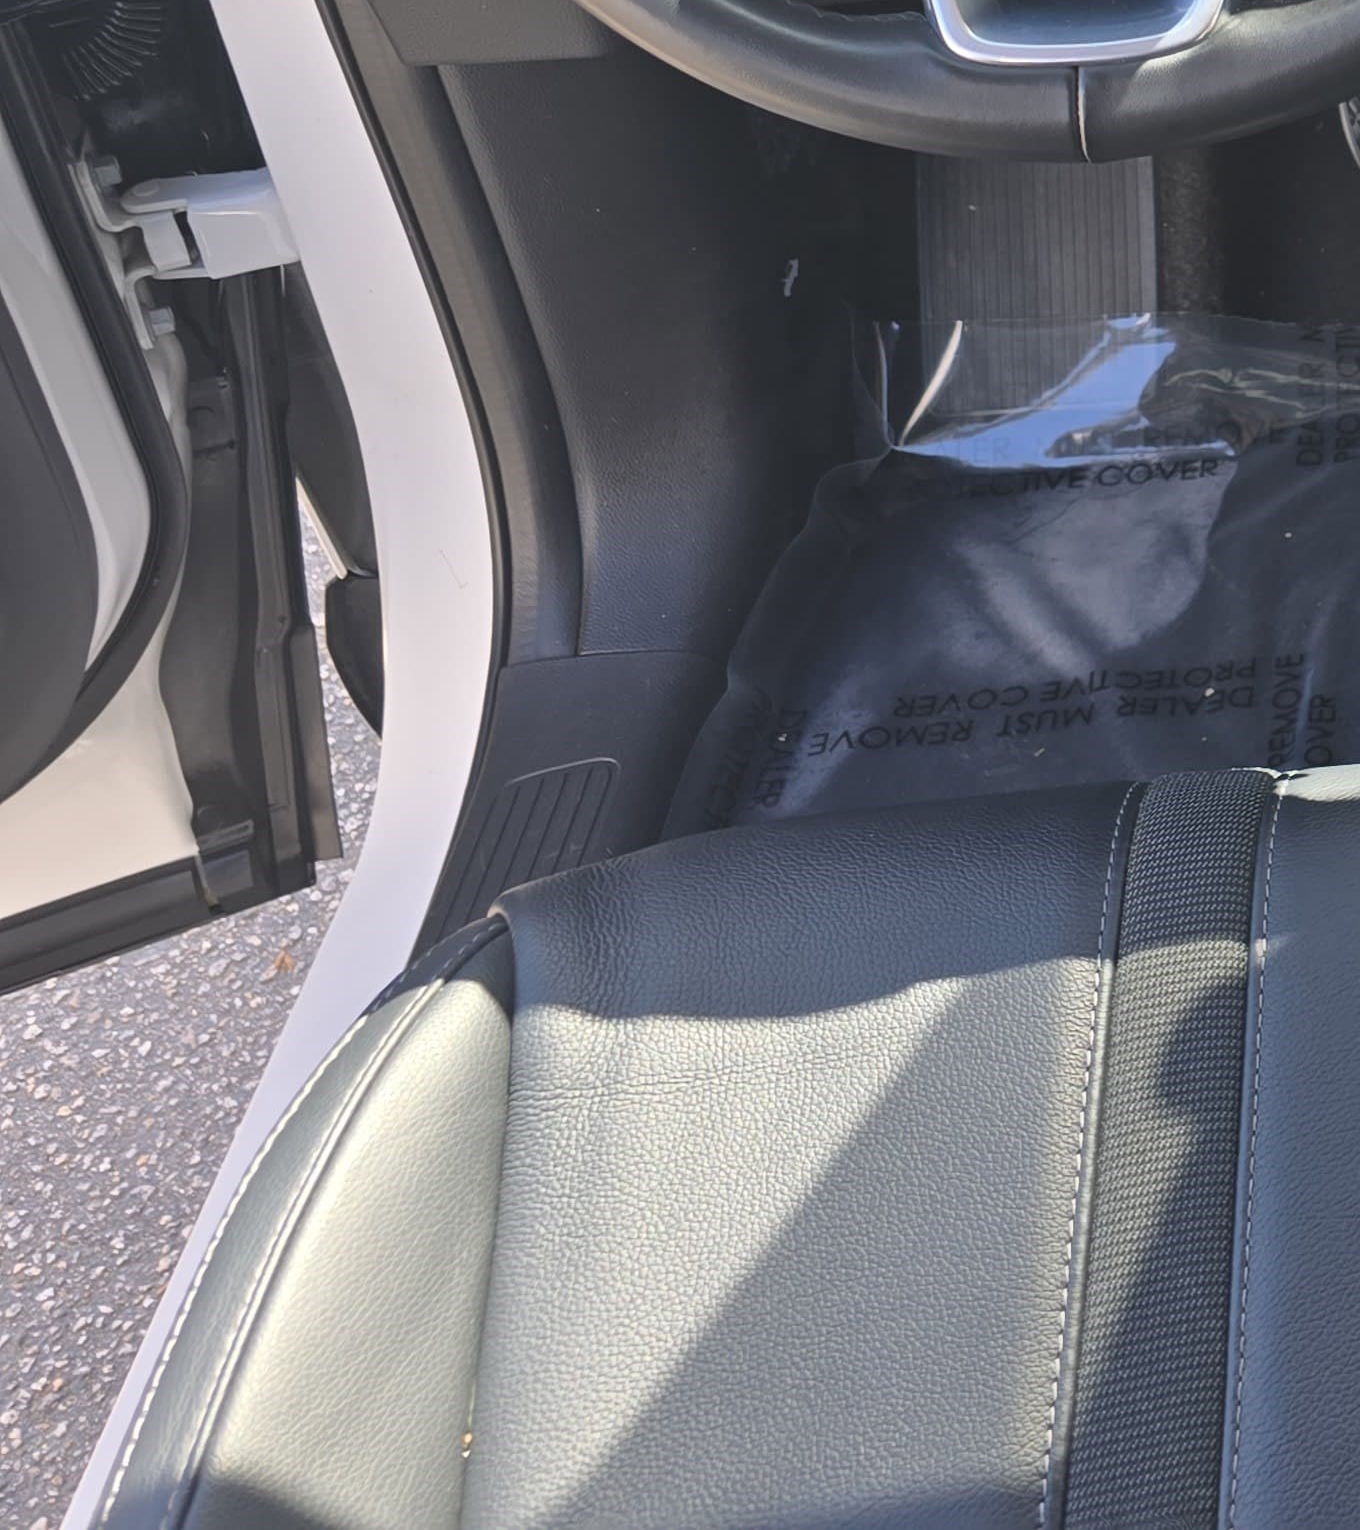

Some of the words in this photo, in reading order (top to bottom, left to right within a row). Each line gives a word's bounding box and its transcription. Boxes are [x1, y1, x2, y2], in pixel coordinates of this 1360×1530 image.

[1095, 459, 1219, 489] COVER
[1039, 656, 1258, 703] PROTECTIVE
[893, 684, 1029, 718] COVER
[1116, 685, 1257, 718] DEALER
[1266, 652, 1306, 768] REMOVE
[807, 719, 975, 757] REMOVE
[995, 703, 1095, 738] MUST
[1303, 693, 1337, 766] OVER
